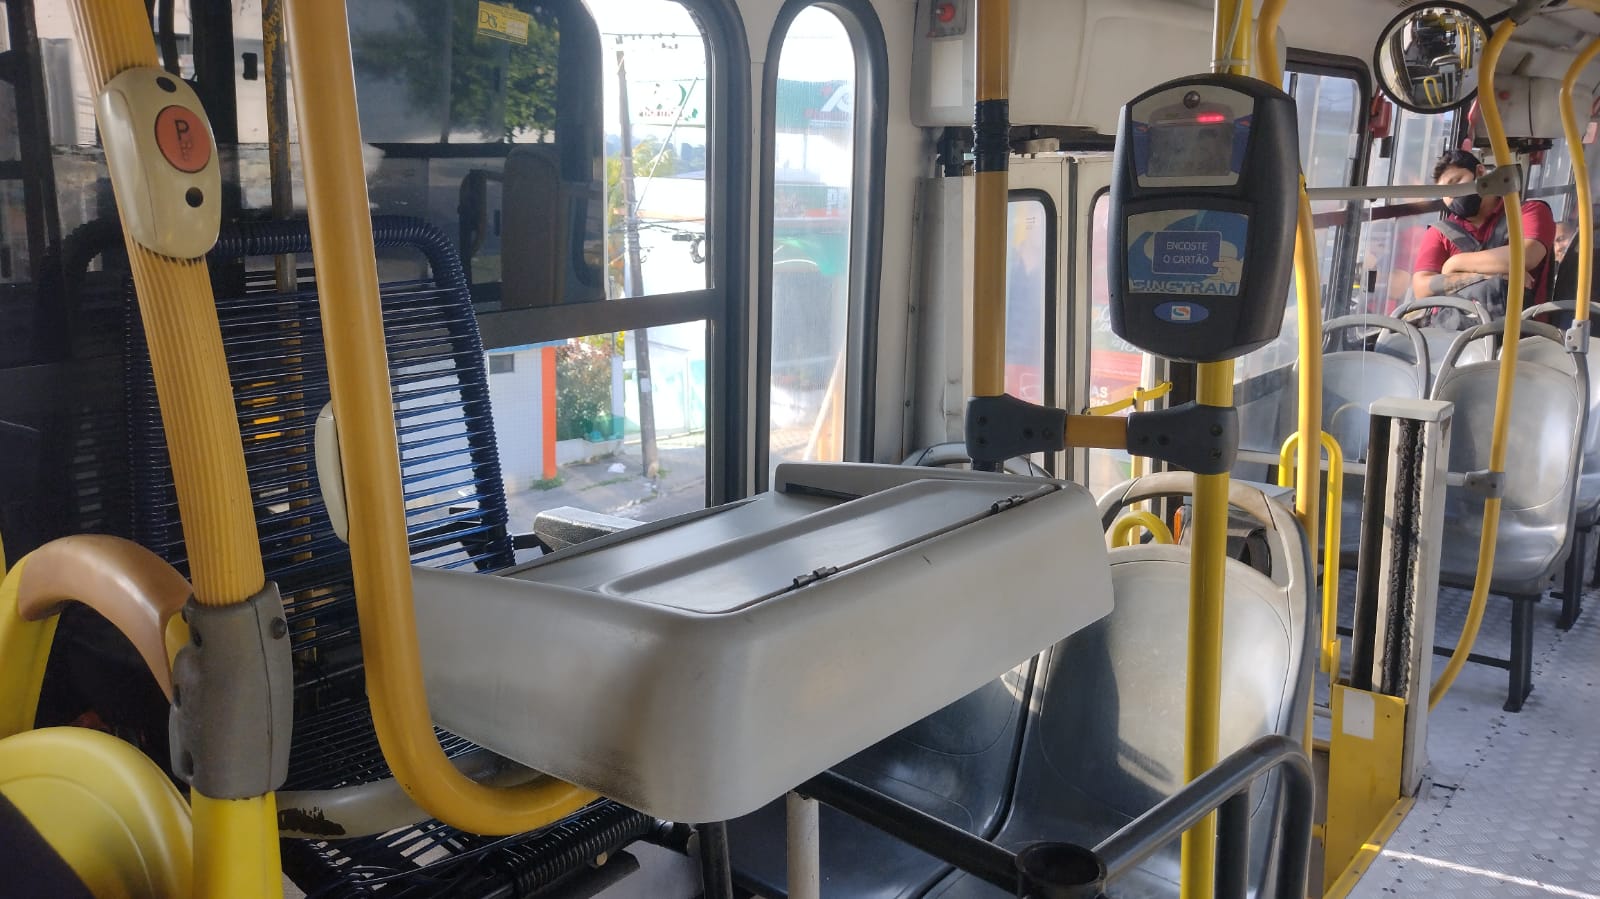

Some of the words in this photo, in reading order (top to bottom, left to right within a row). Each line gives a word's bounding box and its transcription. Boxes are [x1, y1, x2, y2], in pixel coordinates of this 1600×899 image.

[174, 119, 190, 141] P
[1166, 241, 1209, 251] ENCOSTE
[1163, 255, 1170, 263] O
[1172, 253, 1209, 265] CARTÃO
[1133, 279, 1237, 295] SINETRAM
